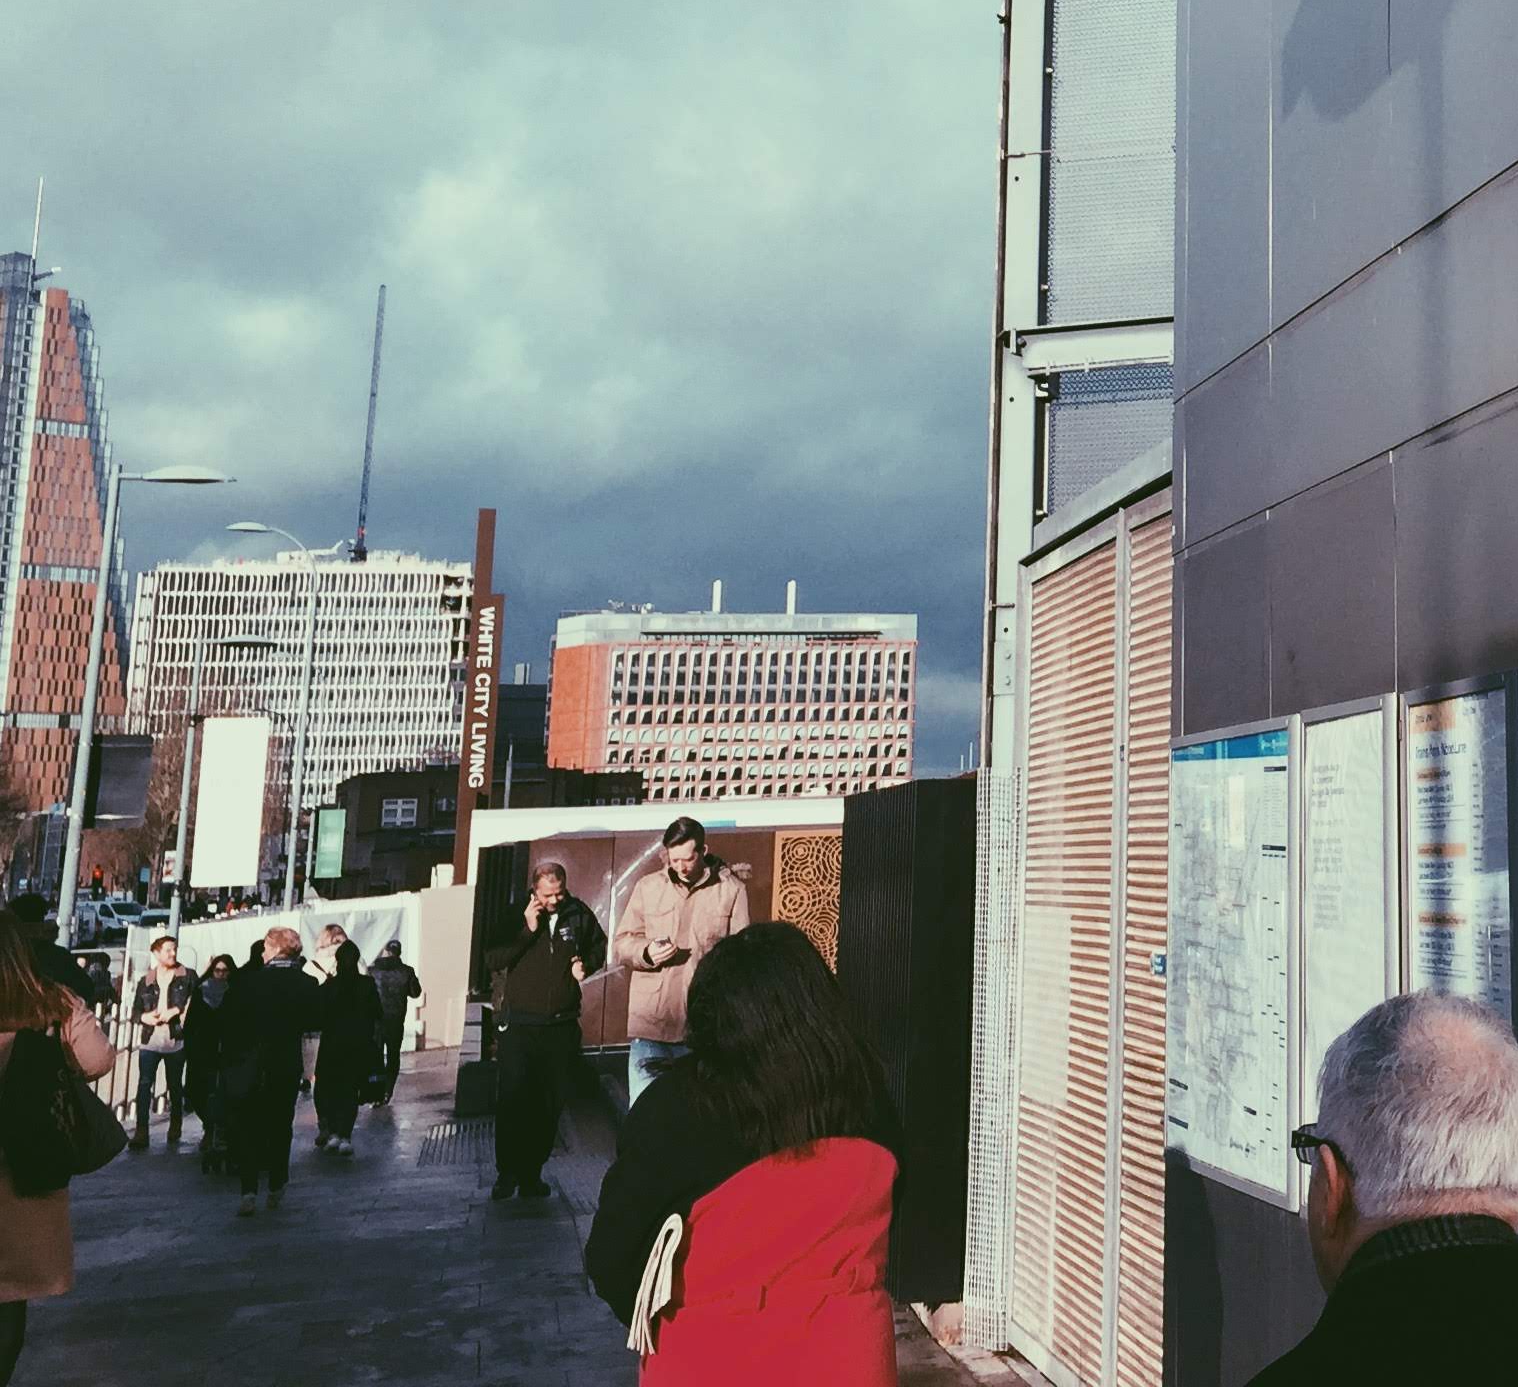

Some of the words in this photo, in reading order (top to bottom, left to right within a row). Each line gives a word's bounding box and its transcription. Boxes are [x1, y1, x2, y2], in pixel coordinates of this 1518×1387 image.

[476, 605, 496, 669] WHITE
[472, 672, 492, 718] CITY
[467, 722, 488, 789] LIVING
